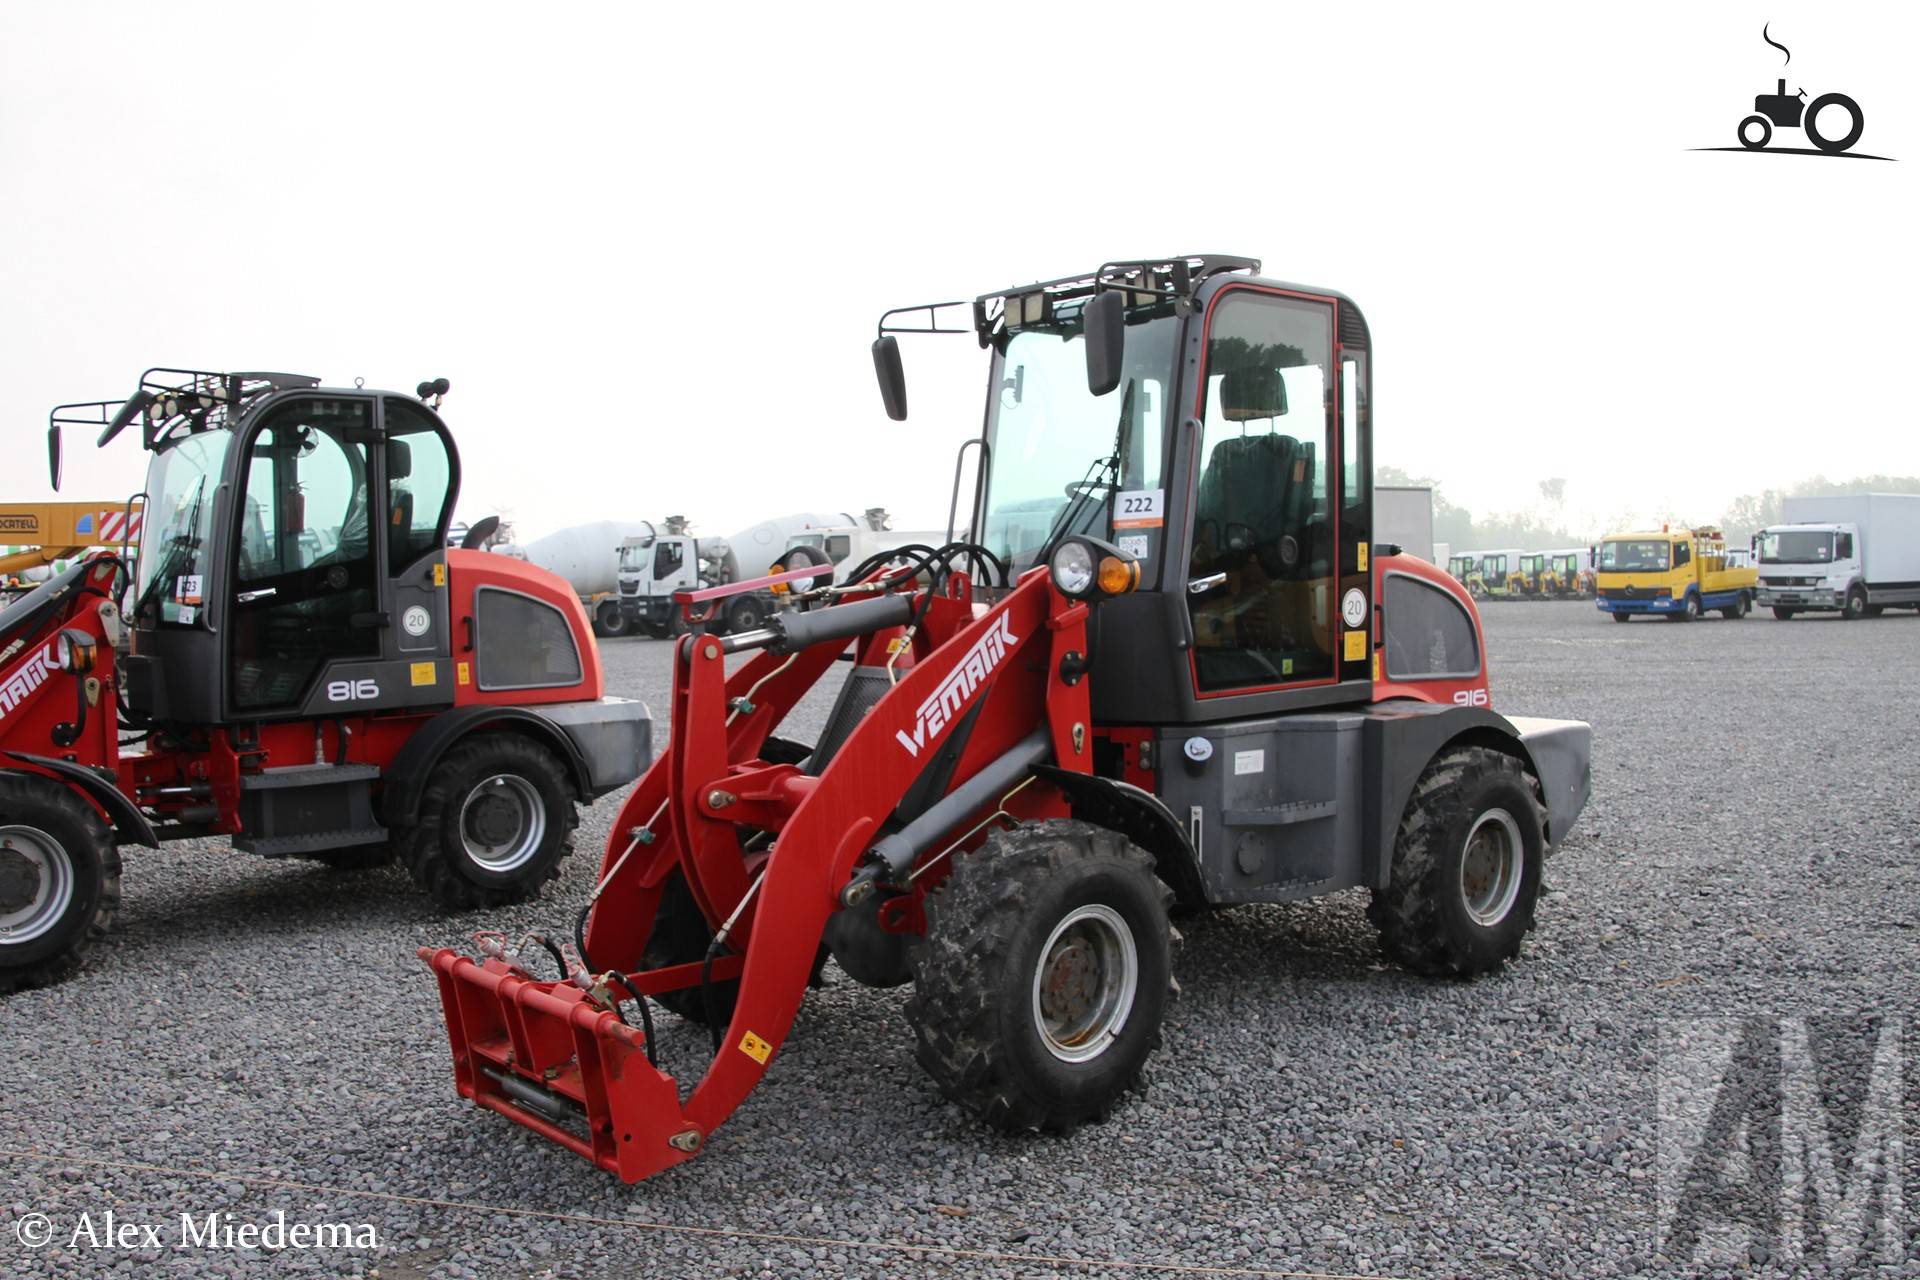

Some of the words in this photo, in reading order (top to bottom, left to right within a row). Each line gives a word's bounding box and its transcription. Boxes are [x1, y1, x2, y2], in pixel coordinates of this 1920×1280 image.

[1124, 497, 1153, 513] 222
[1347, 600, 1362, 615] 20
[408, 614, 425, 627] 20
[327, 678, 380, 702] 816
[1453, 688, 1488, 708] 916
